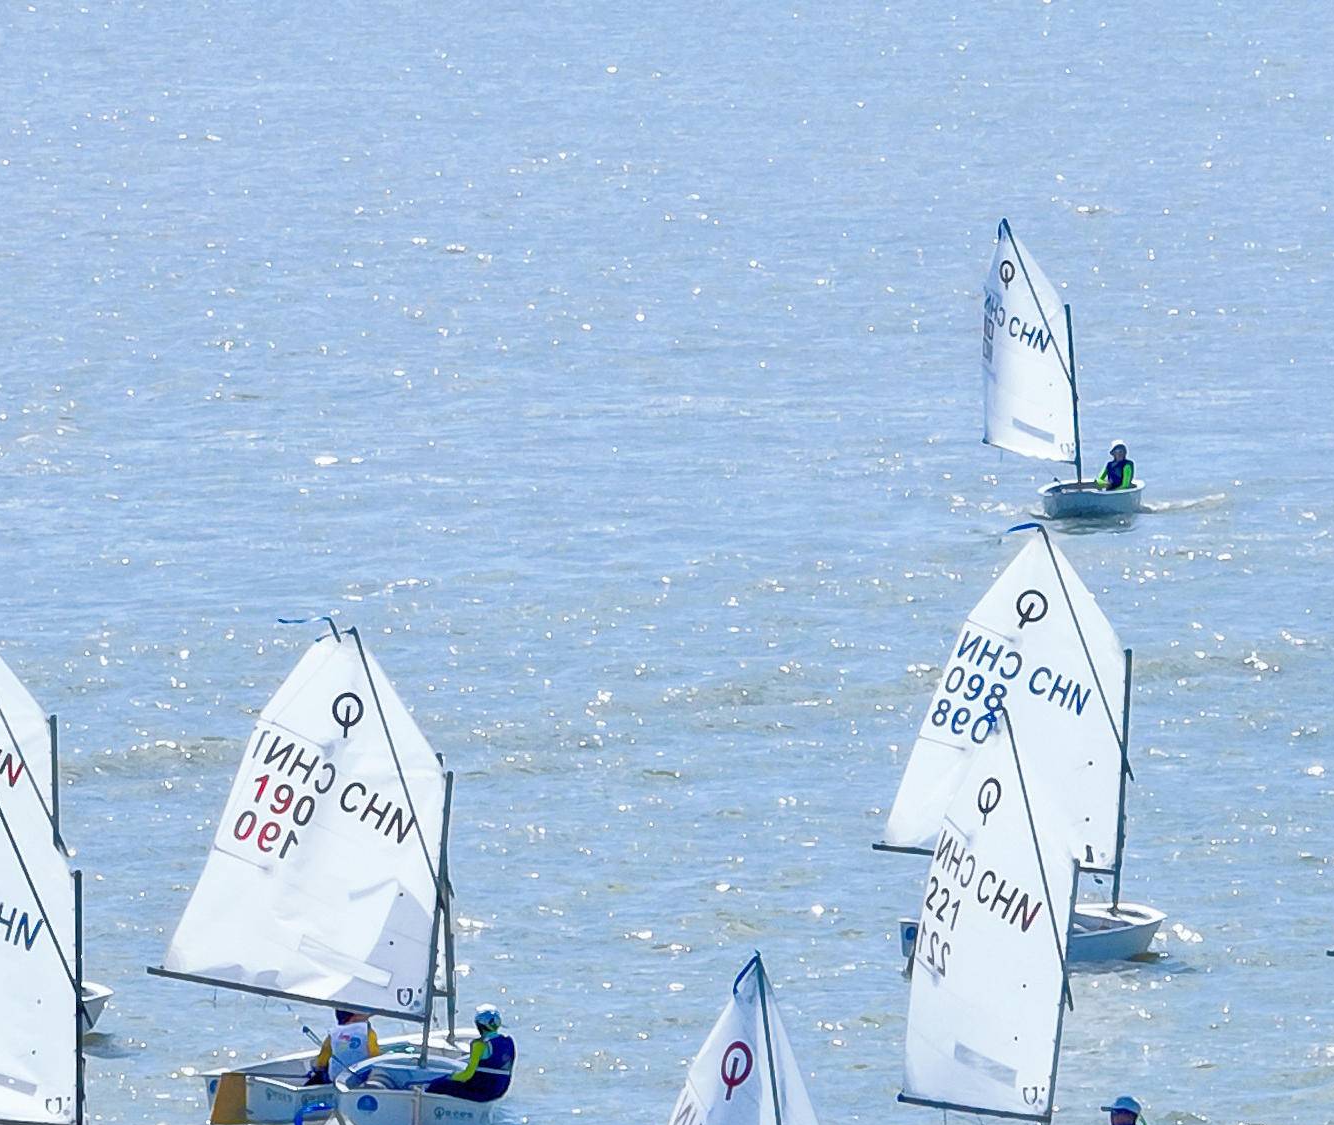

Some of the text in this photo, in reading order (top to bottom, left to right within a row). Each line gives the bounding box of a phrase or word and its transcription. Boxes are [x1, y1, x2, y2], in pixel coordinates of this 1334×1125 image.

[1009, 316, 1051, 353] CHN
[945, 666, 1007, 711] 098
[1029, 667, 1091, 716] CHN
[254, 774, 315, 826] 190
[340, 782, 416, 844] CHN
[926, 876, 961, 931] 221
[977, 870, 1042, 932] CHN
